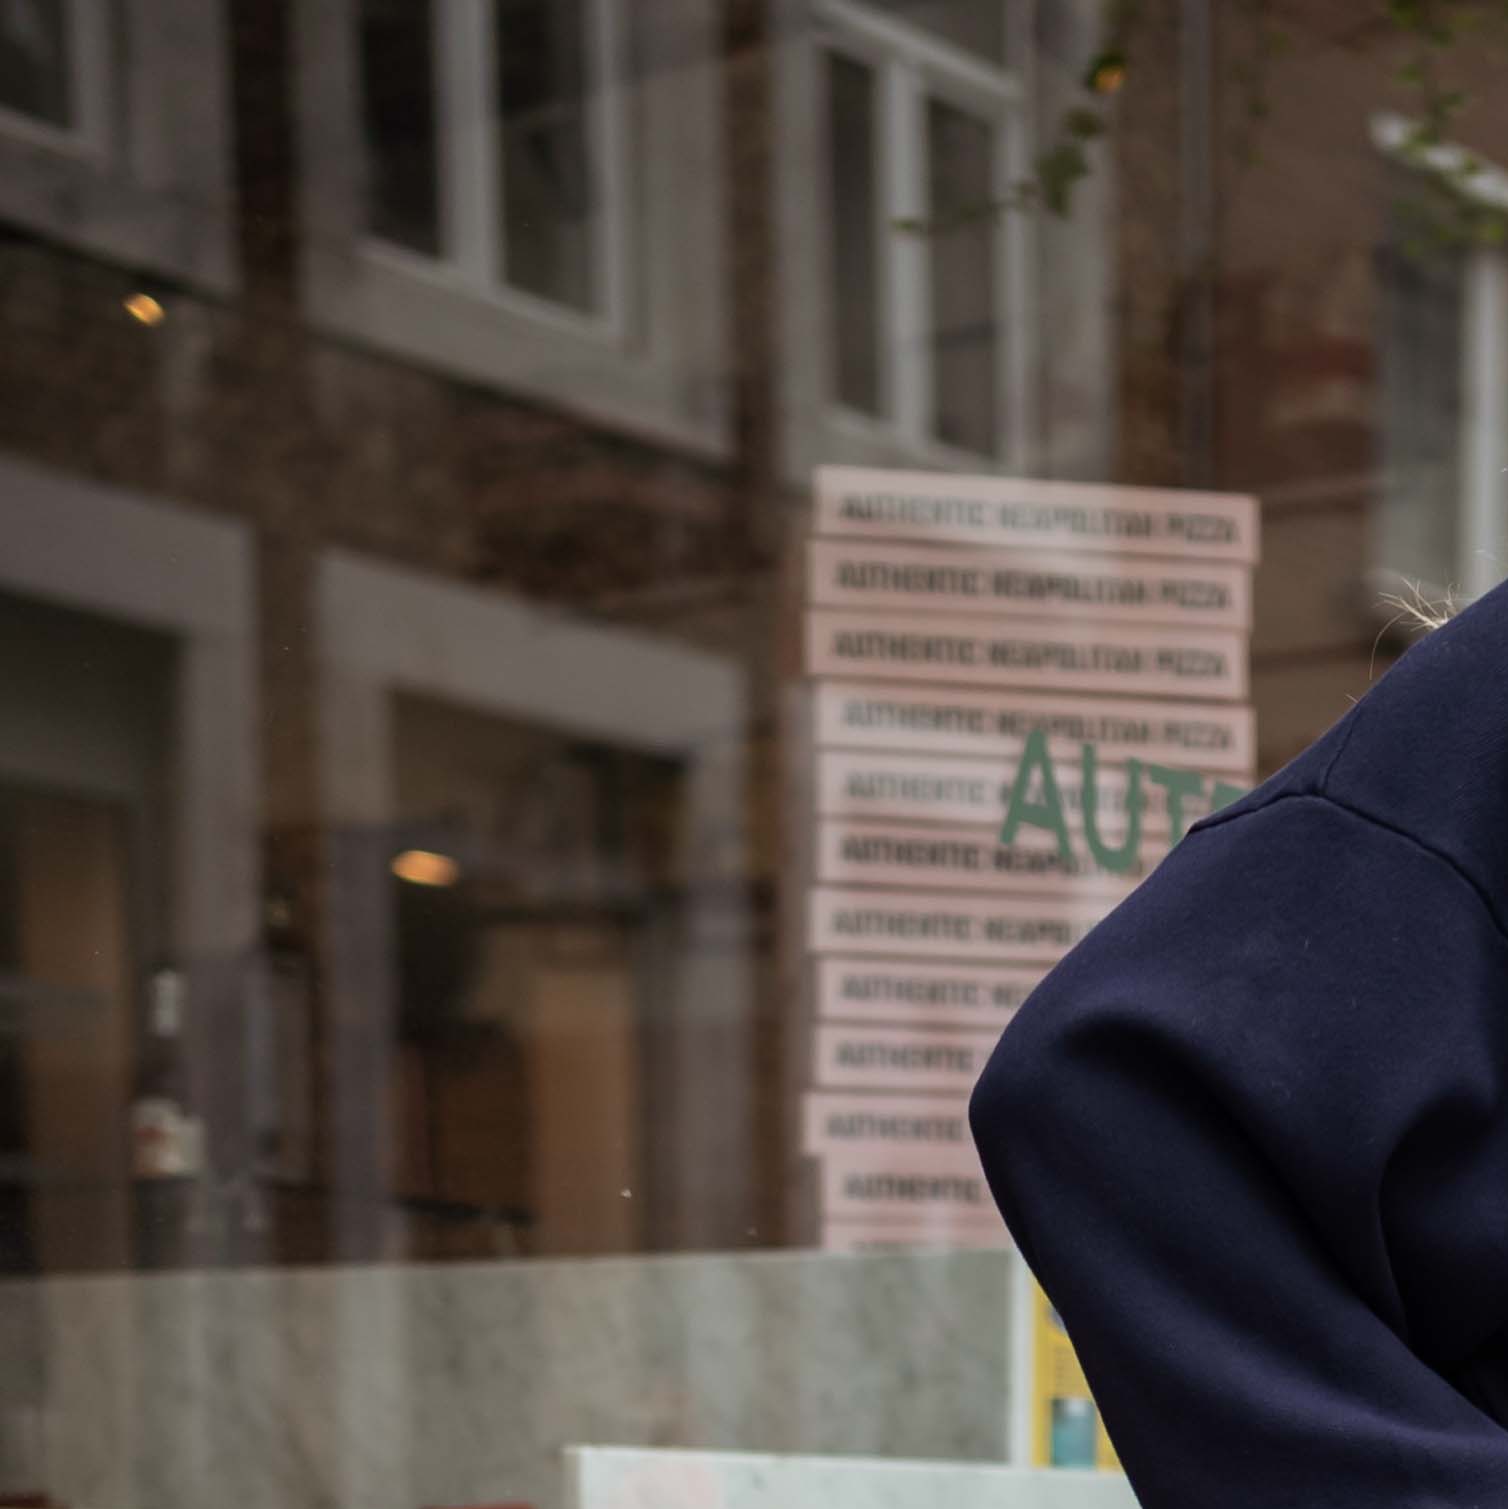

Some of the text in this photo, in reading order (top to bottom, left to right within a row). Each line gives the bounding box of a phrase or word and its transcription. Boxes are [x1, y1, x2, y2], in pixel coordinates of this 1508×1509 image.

[838, 495, 984, 529] AUTHENTIC
[1166, 512, 1239, 544] PIZZA
[834, 559, 1232, 611] AUTHENTIC NEAPOLITAN PIZZA
[830, 629, 1228, 679] AUTHENTIC NEAPOLITAN PIZZA
[842, 698, 983, 734] AUTHENTIC
[1163, 718, 1233, 750] PIZZA
[841, 833, 980, 871] AUTHENTIC
[832, 910, 972, 943] AUTHENTIC
[842, 974, 978, 1006] AUTHENTIC
